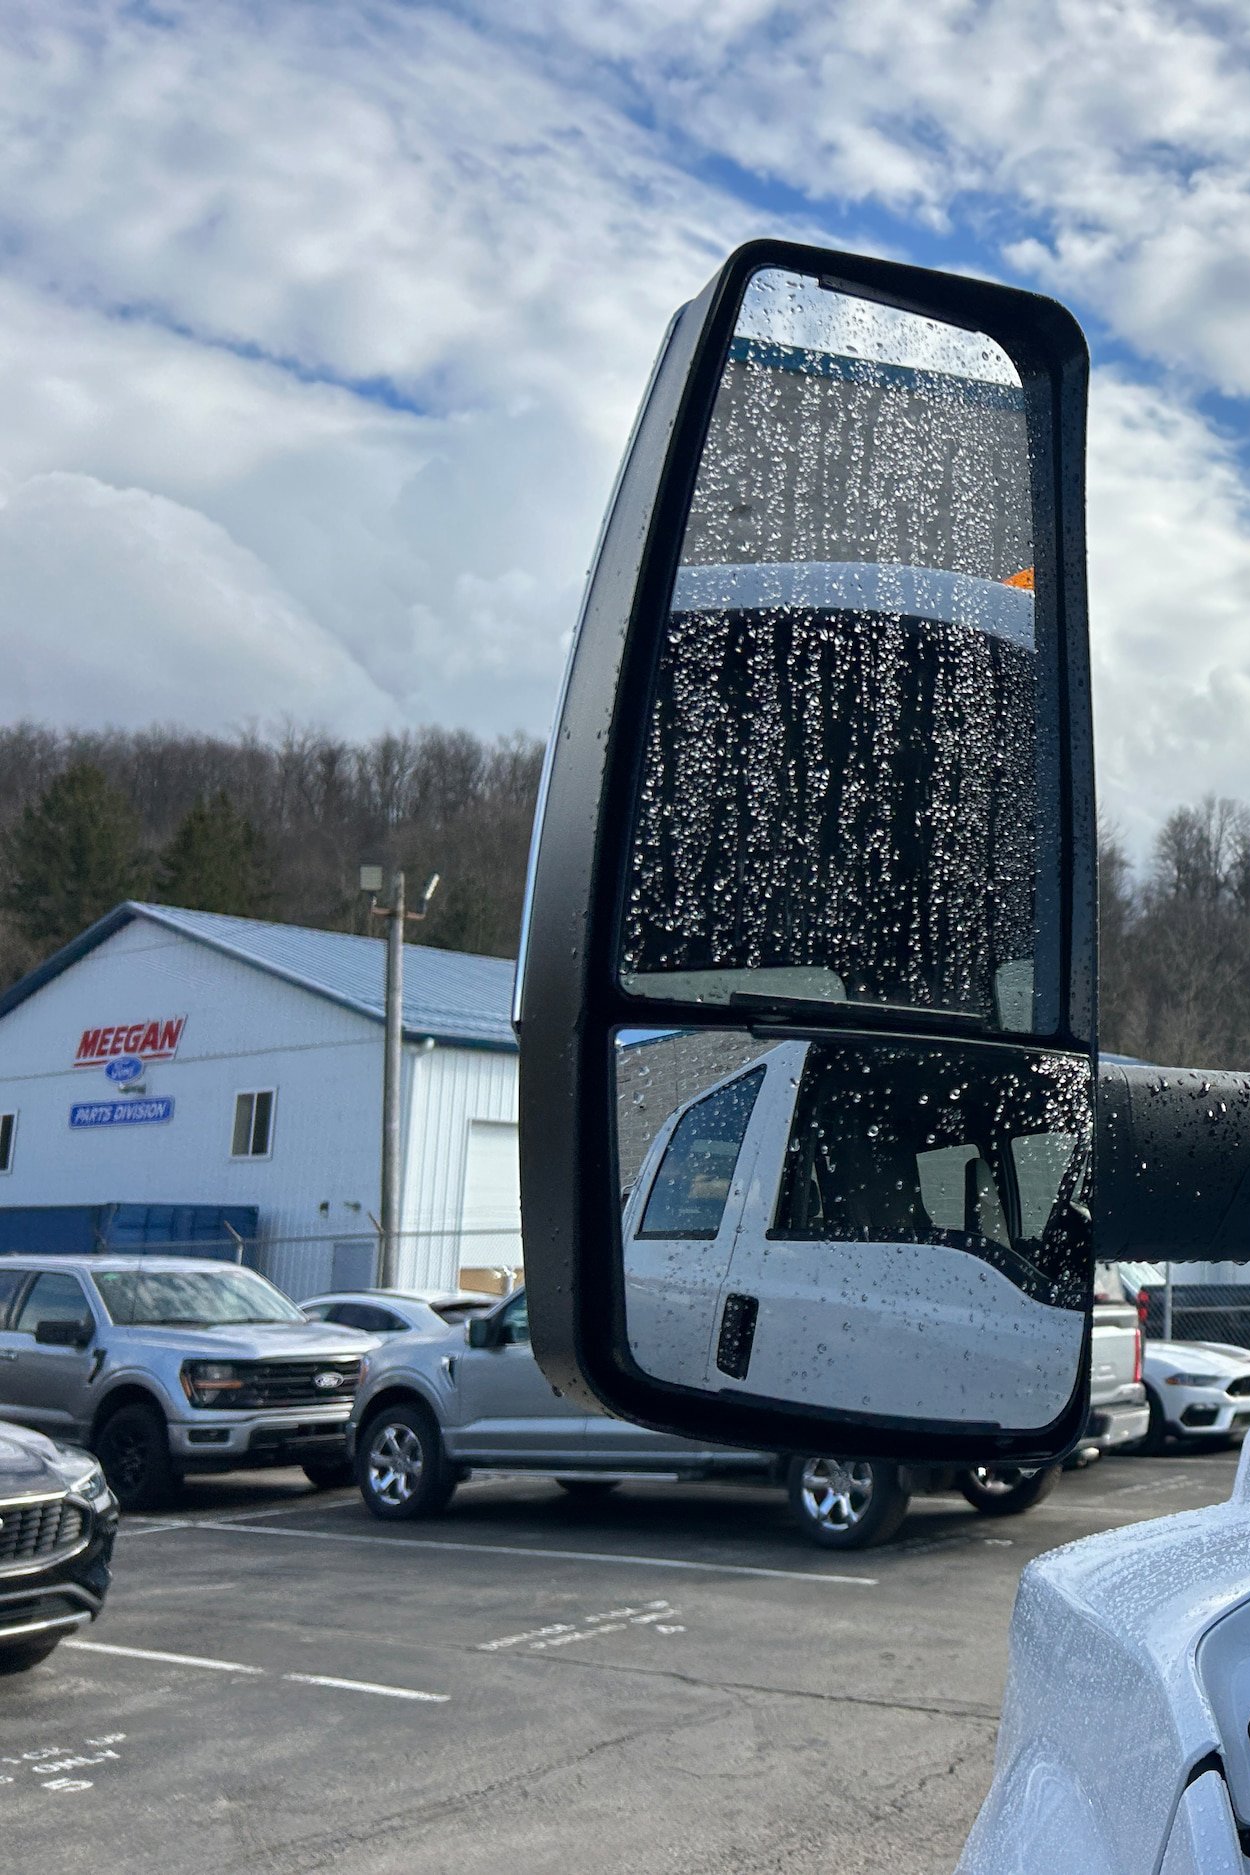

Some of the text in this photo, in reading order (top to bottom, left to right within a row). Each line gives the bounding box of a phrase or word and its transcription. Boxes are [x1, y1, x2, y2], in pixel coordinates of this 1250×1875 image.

[76, 1019, 184, 1059] MEEGAN
[74, 1101, 168, 1124] PARTS DIVISION
[32, 1749, 120, 1773] ONLY
[41, 1777, 94, 1793] 5
